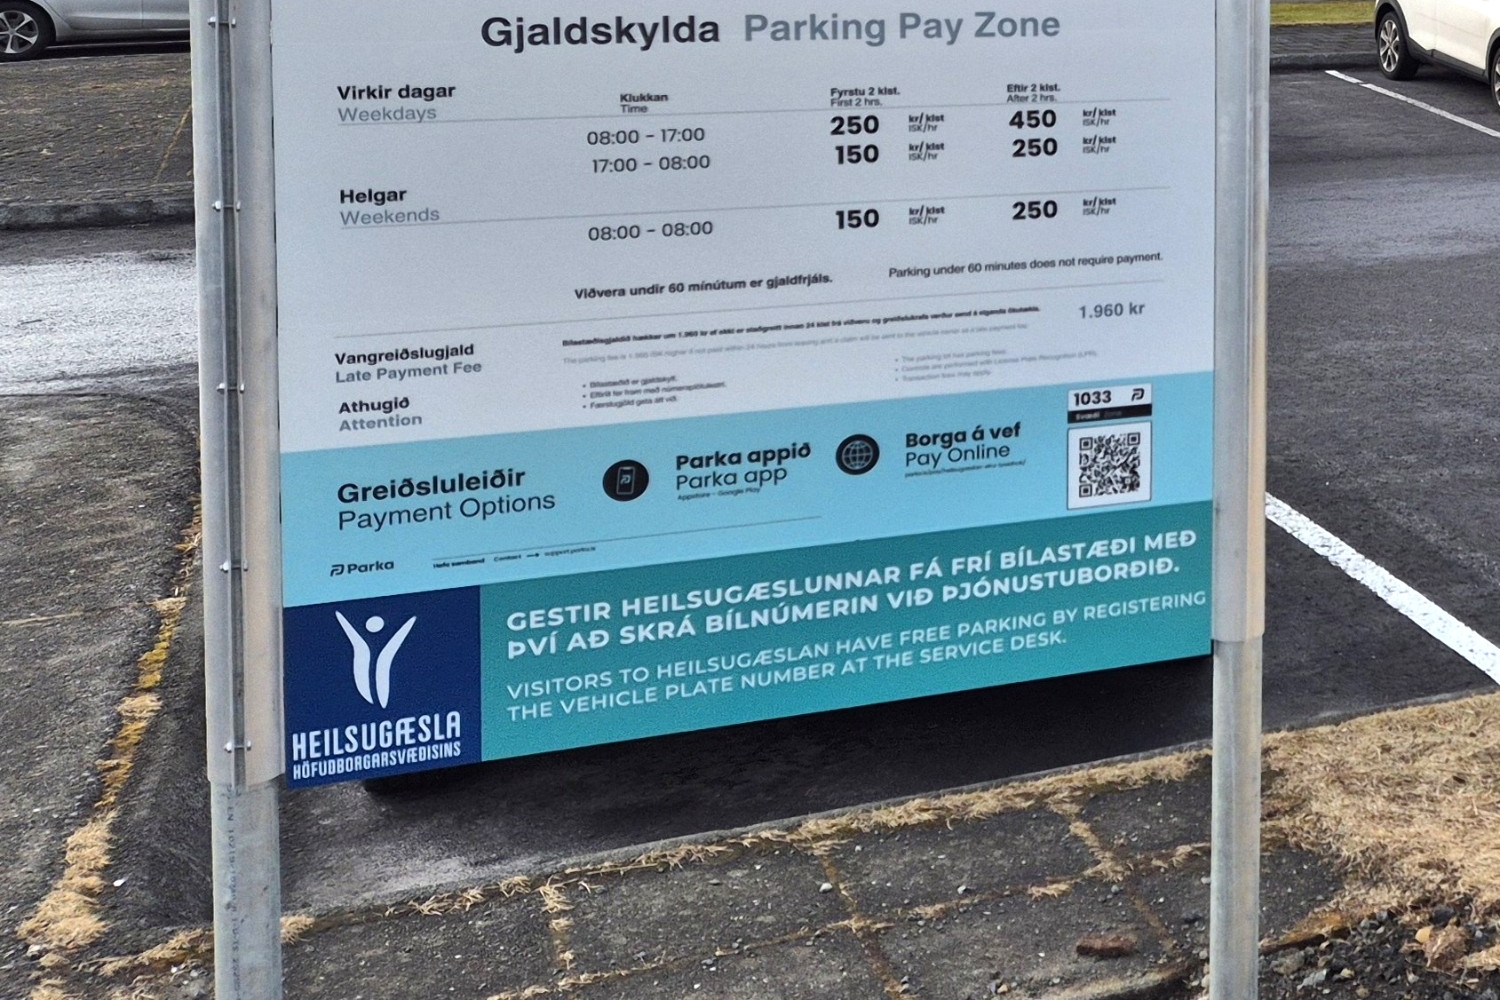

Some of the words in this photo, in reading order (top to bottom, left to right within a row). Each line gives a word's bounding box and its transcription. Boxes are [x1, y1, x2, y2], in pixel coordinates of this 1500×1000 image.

[481, 16, 720, 53] Gjaldskylda
[745, 13, 886, 47] Parking
[900, 12, 964, 45] Pay
[974, 11, 1060, 38] Zone
[337, 85, 392, 100] Virkir
[398, 84, 456, 102] dagar
[620, 93, 668, 102] Klukkan
[830, 87, 865, 99] Fyrstu
[868, 87, 874, 95] 2
[878, 87, 900, 95] klst.
[1007, 84, 1028, 93] Eftir
[1031, 84, 1037, 92] 2
[1040, 84, 1060, 92] klst.
[1007, 94, 1029, 102] After
[1031, 94, 1037, 102] 2
[1040, 94, 1057, 102] hrs.
[620, 104, 648, 113] Time
[830, 98, 853, 107] First
[855, 98, 861, 106] 2
[864, 97, 882, 106] hrs.
[338, 106, 437, 123] Weekdays
[1009, 109, 1056, 129] 450
[830, 115, 879, 135] 250
[587, 130, 639, 145] 08:00
[660, 127, 705, 142] 17:00
[835, 144, 879, 164] 150
[1012, 138, 1057, 157] 250
[592, 158, 637, 173] 17:00
[658, 155, 711, 170] 08:00
[340, 189, 408, 206] Helgar
[340, 208, 440, 226] Weekends
[835, 209, 880, 229] 150
[1012, 200, 1057, 220] 250
[588, 225, 641, 241] 08:00
[661, 221, 713, 237] 08:00
[889, 265, 930, 279] Parking
[933, 263, 965, 276] under
[968, 263, 982, 273] 60
[985, 259, 1027, 272] minutes
[1030, 258, 1055, 269] does
[1058, 256, 1075, 267] not
[1078, 255, 1114, 268] require
[1117, 252, 1163, 266] payment.
[575, 286, 626, 300] Viðvera
[630, 284, 665, 296] undir
[668, 282, 684, 293] 60
[688, 280, 746, 292] mínútum
[750, 279, 762, 288] er
[766, 272, 833, 289] gjaldfrjáls.
[1078, 303, 1124, 320] 1.960
[1129, 302, 1145, 316] kr
[335, 344, 474, 365] Vangreiðslugjald
[336, 369, 371, 383] Late
[377, 362, 448, 381] Payment
[453, 361, 482, 374] Fee
[338, 396, 410, 414] Athugið
[1074, 390, 1112, 407] 1033
[339, 414, 422, 432] Attention
[906, 429, 967, 450] Borga
[972, 426, 984, 442] á
[991, 422, 1021, 439] vef
[676, 451, 742, 471] Parka
[747, 442, 811, 466] appið
[906, 451, 942, 470] Pay
[948, 443, 1011, 463] Online
[337, 468, 525, 504] Greiðsluleiðir
[676, 471, 737, 490] Parka
[744, 467, 788, 486] app
[338, 502, 452, 532] Payment
[460, 494, 556, 521] Options
[347, 560, 394, 574] Parka
[506, 601, 611, 632] GESTIR
[622, 565, 900, 618] HEILSUGÆSLUNNAR
[910, 556, 942, 581] FÁ
[952, 550, 990, 576] FRÍ
[1000, 536, 1136, 569] BÍLASTÆÐI
[1144, 529, 1197, 550] MEÐ
[508, 633, 558, 660] ÞVÍ
[567, 628, 610, 652] AÐ
[620, 617, 696, 646] SKRÁ
[706, 593, 878, 634] BÍLNÚMERIN
[887, 587, 934, 609] VIÐ
[942, 556, 1180, 602] ÞJÓNUSTUBORÐIÐ.
[507, 670, 612, 700] VISITORS
[618, 666, 650, 684] TO
[656, 642, 828, 680] HEILSUGÆSLAN
[836, 632, 892, 655] HAVE
[900, 624, 951, 646] FREE
[958, 611, 1047, 638] PARKING
[1052, 607, 1078, 625] BY
[1083, 590, 1206, 621] REGISTERING
[507, 701, 552, 722] THE
[560, 686, 658, 714] VEHICLE
[666, 677, 733, 700] PLATE
[740, 661, 834, 690] NUMBER
[840, 657, 864, 676] AT
[876, 648, 913, 670] THE
[920, 638, 1004, 664] SERVICE
[1010, 630, 1066, 652] DESK.
[292, 710, 461, 762] HEILSUGÆSLA
